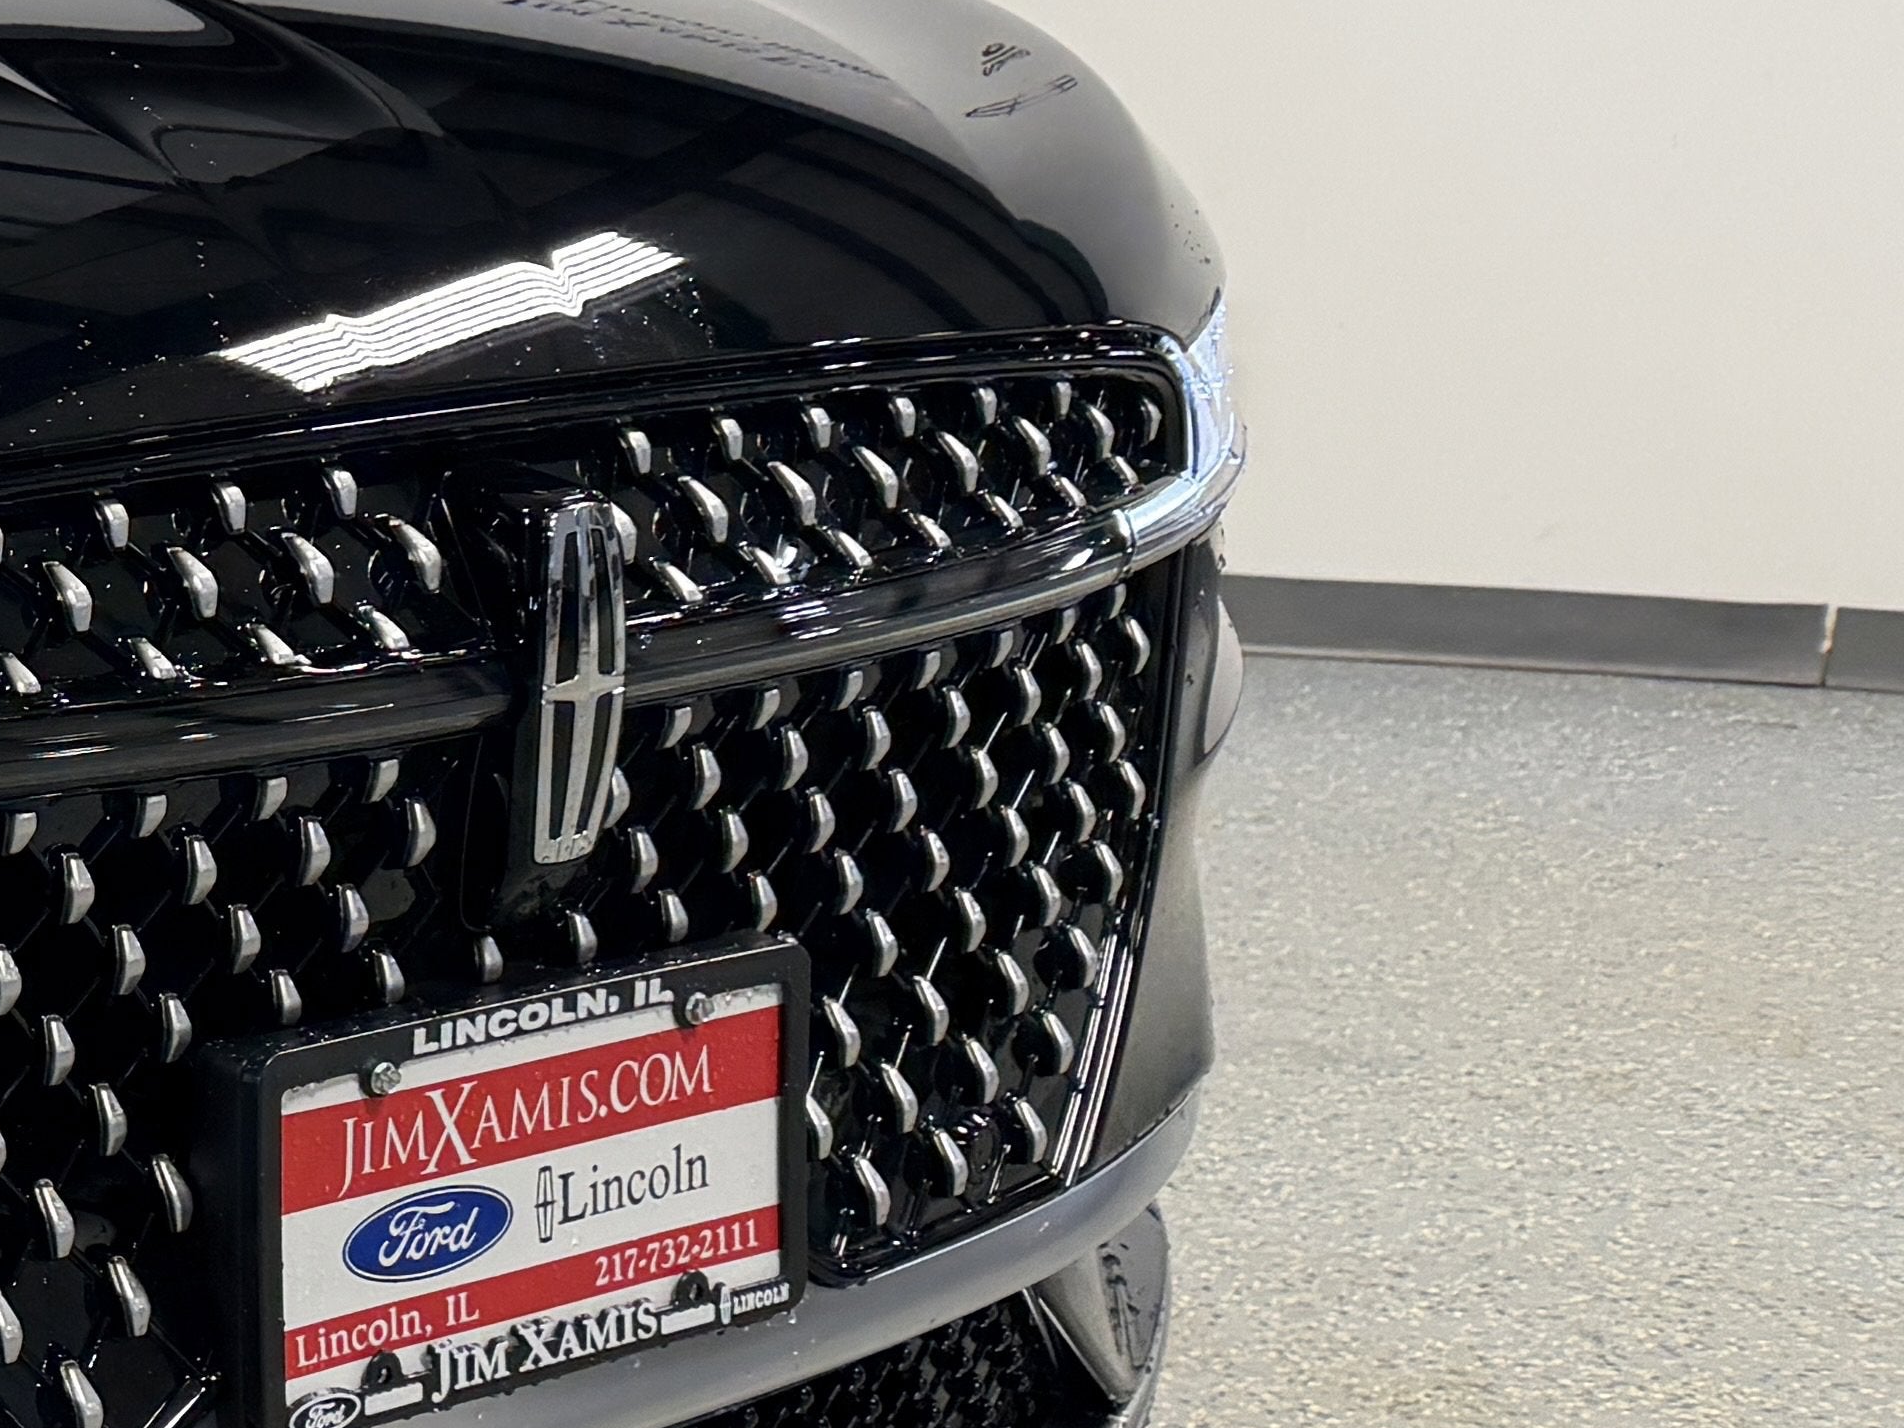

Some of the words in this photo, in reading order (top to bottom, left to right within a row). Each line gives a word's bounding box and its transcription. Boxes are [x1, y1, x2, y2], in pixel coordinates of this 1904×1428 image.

[412, 988, 620, 1056] LINCOLN,
[633, 977, 675, 1006] IL
[557, 1143, 709, 1226] Lincoln
[377, 1199, 480, 1268] Ford
[594, 1217, 759, 1288] 217-732-2111
[295, 1306, 434, 1369] Lincoln,
[445, 1290, 481, 1329] IL
[731, 1280, 791, 1314] LINCOLN
[430, 1338, 510, 1403] JIM
[516, 1301, 661, 1372] XAMIS
